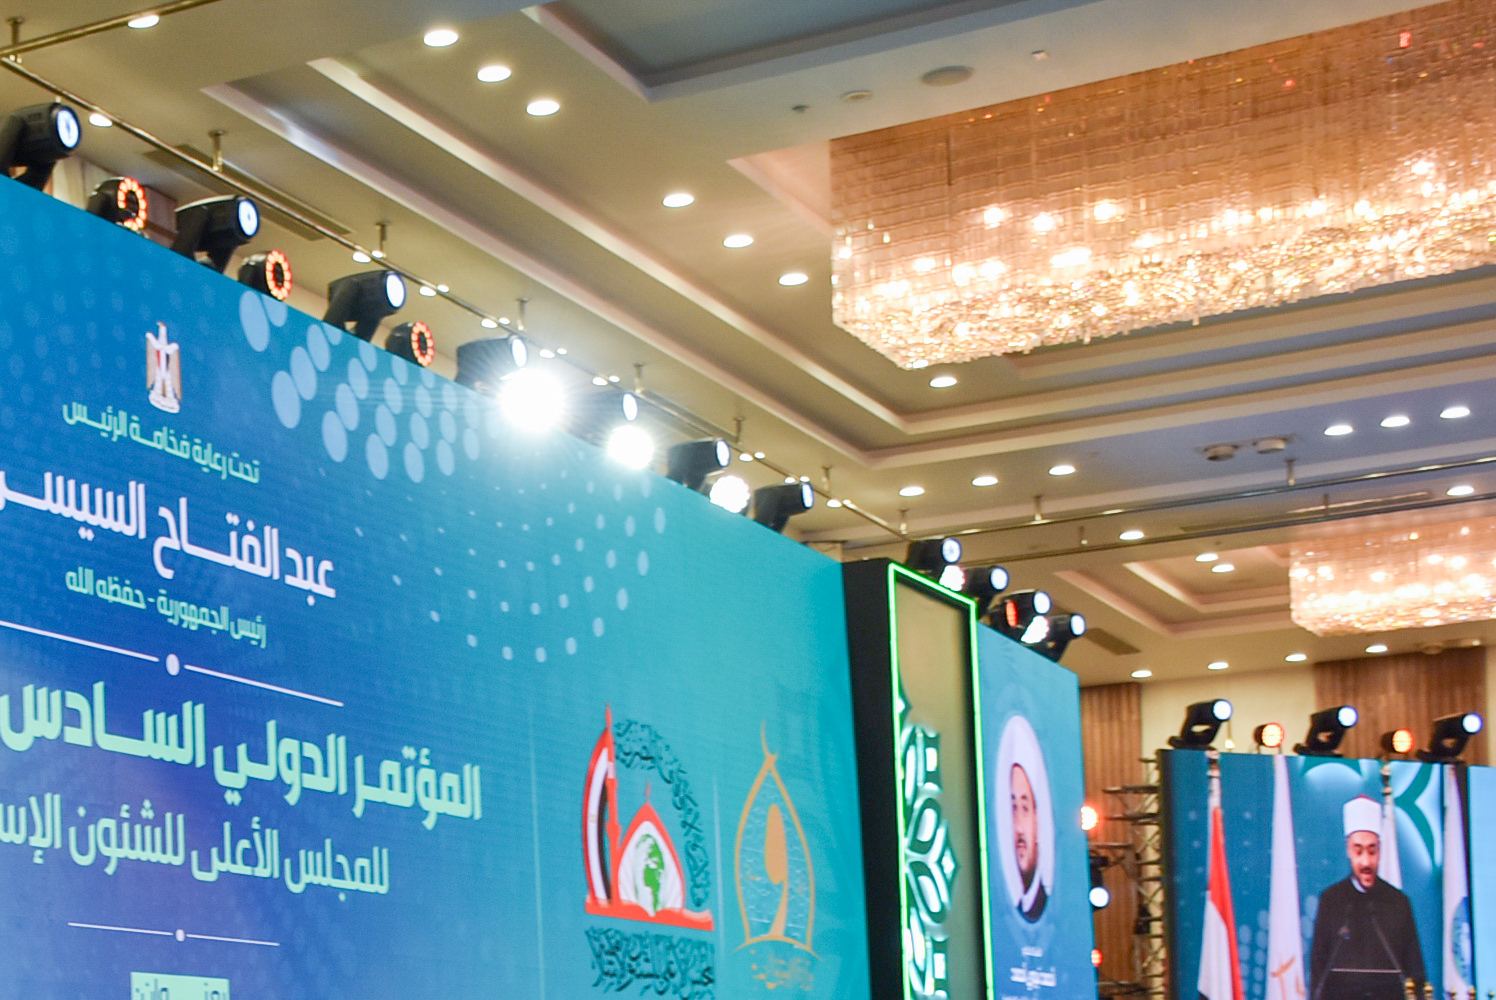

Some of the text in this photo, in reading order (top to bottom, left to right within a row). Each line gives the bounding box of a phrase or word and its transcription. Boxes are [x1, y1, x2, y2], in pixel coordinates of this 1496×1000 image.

[62, 401, 260, 483] تحت رعاية فخامة الرئيس
[153, 497, 280, 579] الفتاح
[65, 566, 94, 595] الله
[96, 576, 147, 609] حفظه
[284, 547, 336, 606] عبد
[157, 588, 229, 635] الجمهورية
[230, 615, 267, 649] رئيس
[213, 720, 347, 806] الدولي
[353, 745, 482, 830] المؤتمر
[68, 799, 186, 875] للشئون
[191, 816, 280, 881] الأعلى
[284, 838, 389, 901] للمجلس
